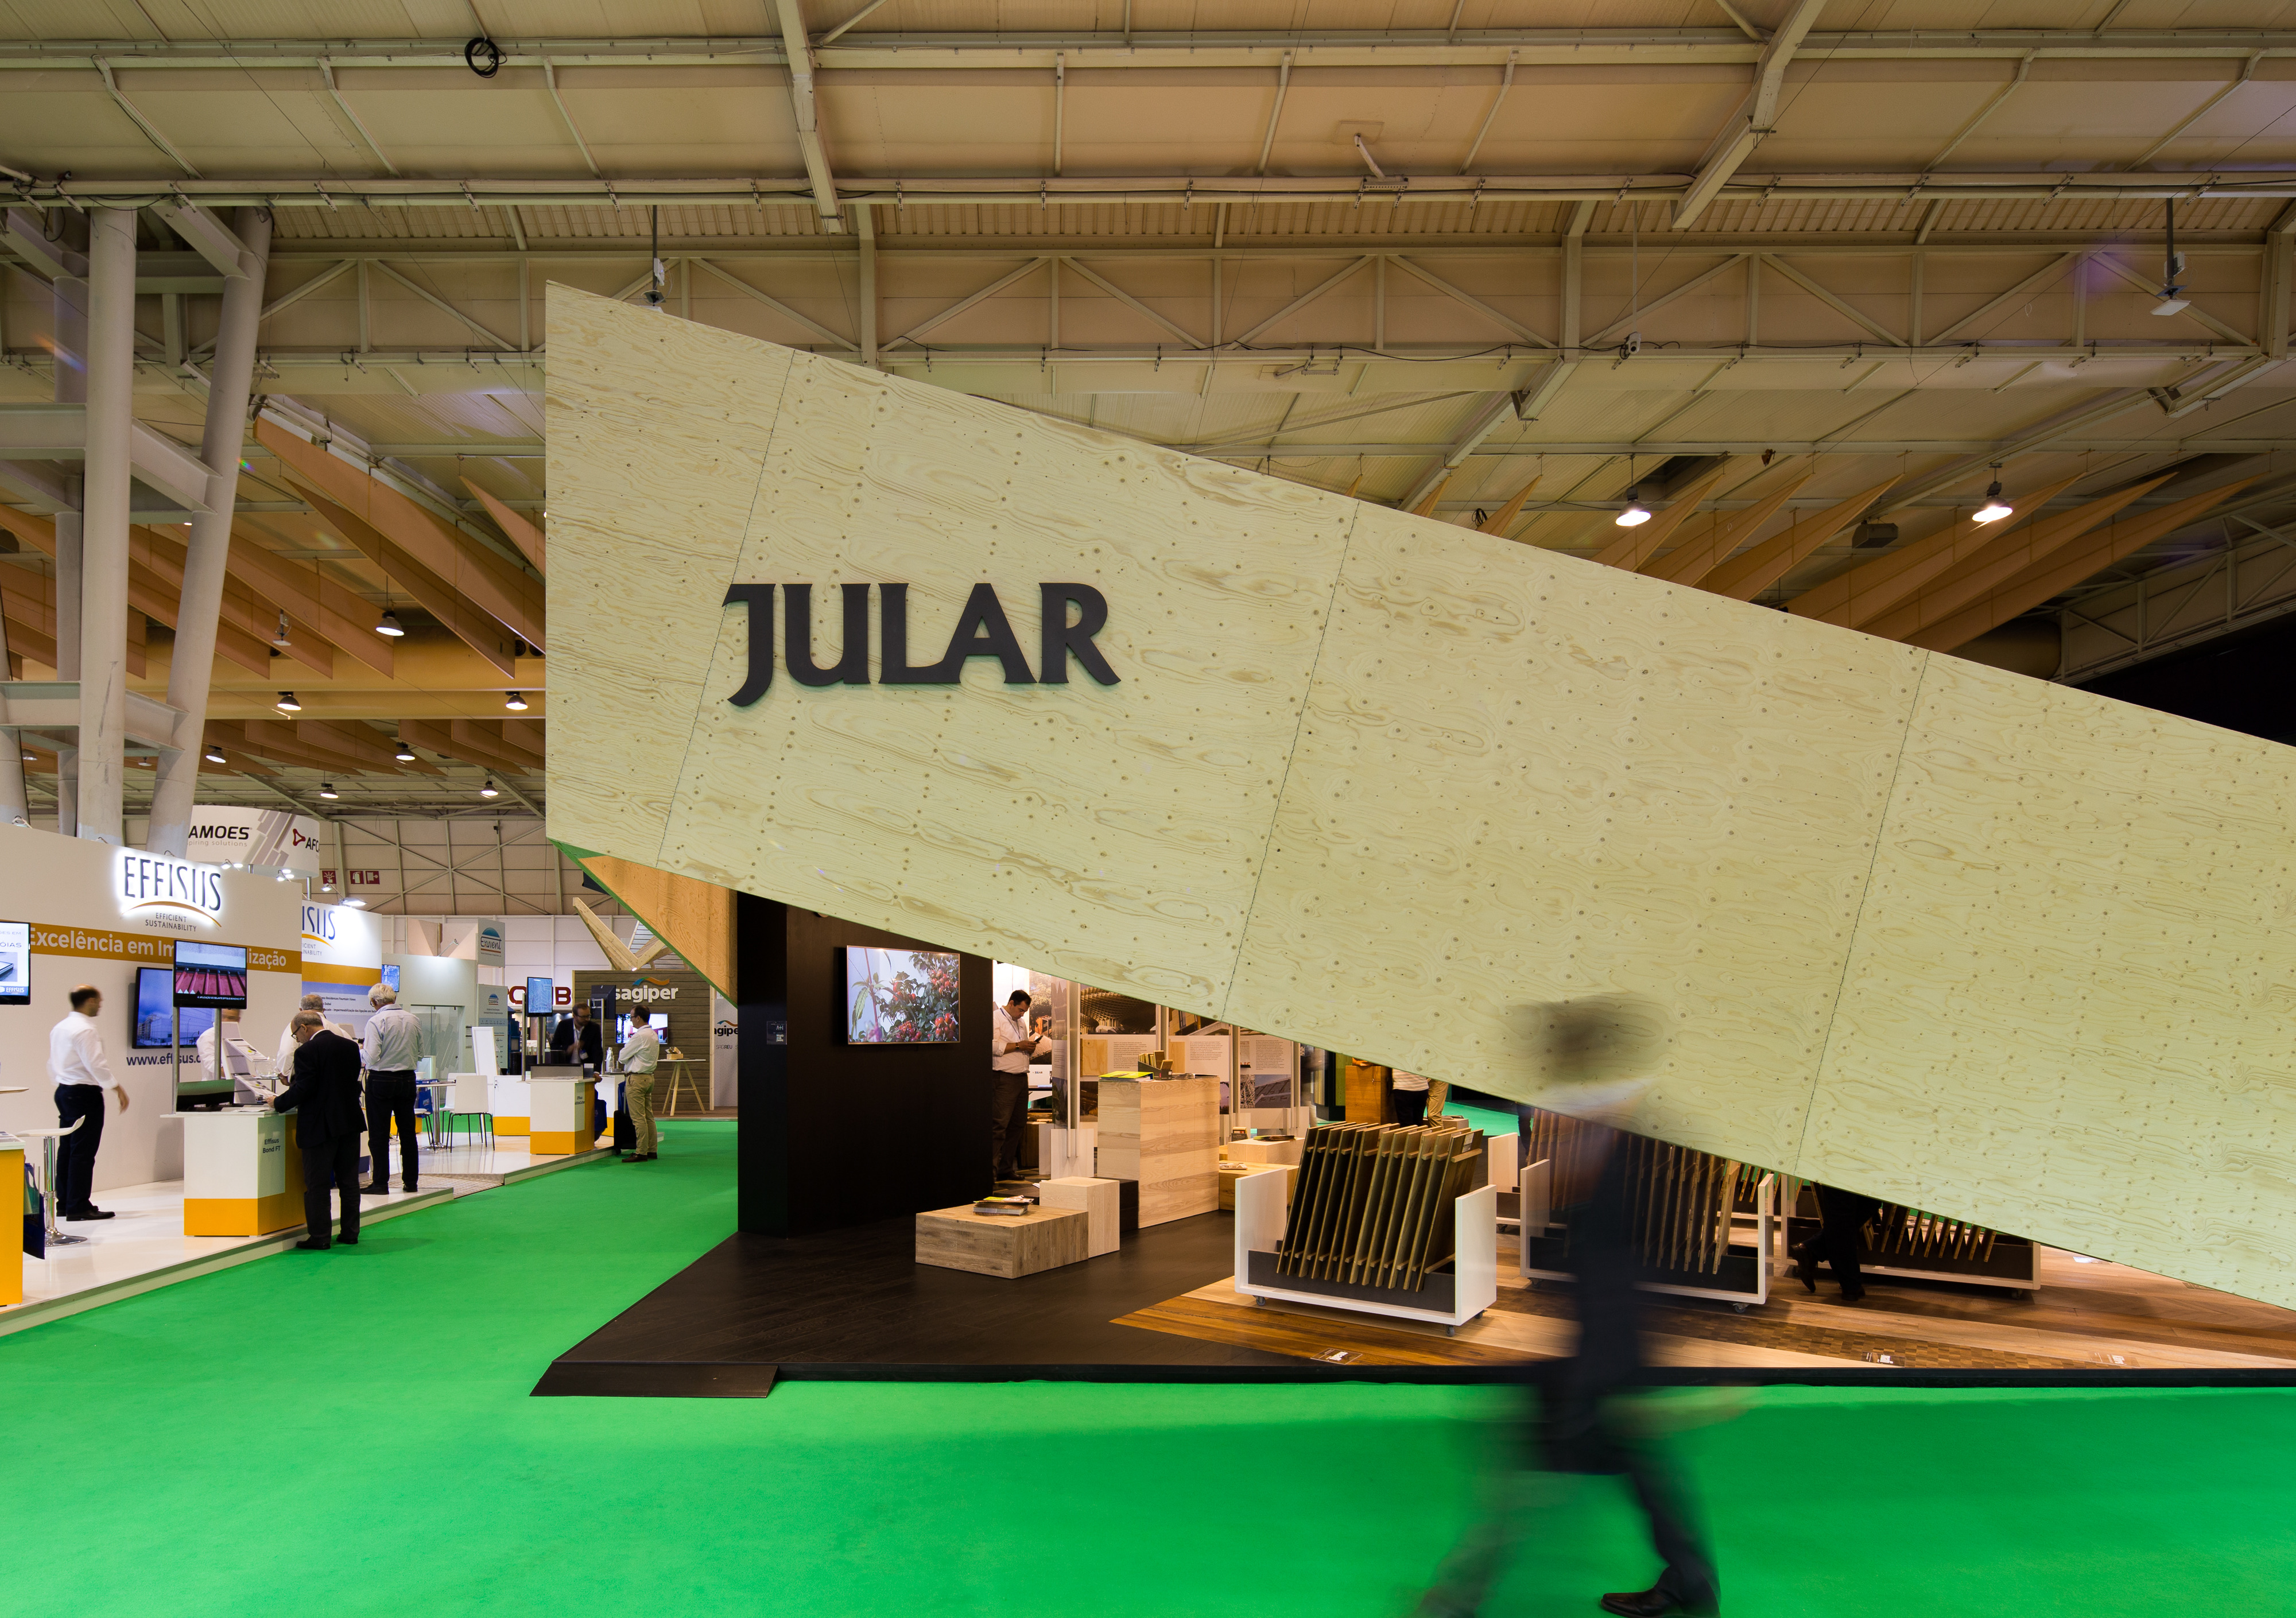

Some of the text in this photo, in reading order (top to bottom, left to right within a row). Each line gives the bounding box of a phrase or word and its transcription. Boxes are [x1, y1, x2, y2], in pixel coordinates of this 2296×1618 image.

[722, 583, 1122, 707] JULAR
[125, 856, 221, 911] EFFISUS
[145, 919, 197, 932] SUSTAINABILITY
[156, 913, 187, 922] EFFICIENT
[302, 906, 335, 940] ISUS
[127, 940, 154, 956] em
[158, 940, 174, 957] Im
[247, 948, 286, 969] ização
[615, 985, 678, 1003] sagiper
[714, 1025, 738, 1037] gipe
[262, 1146, 275, 1154] Bond
